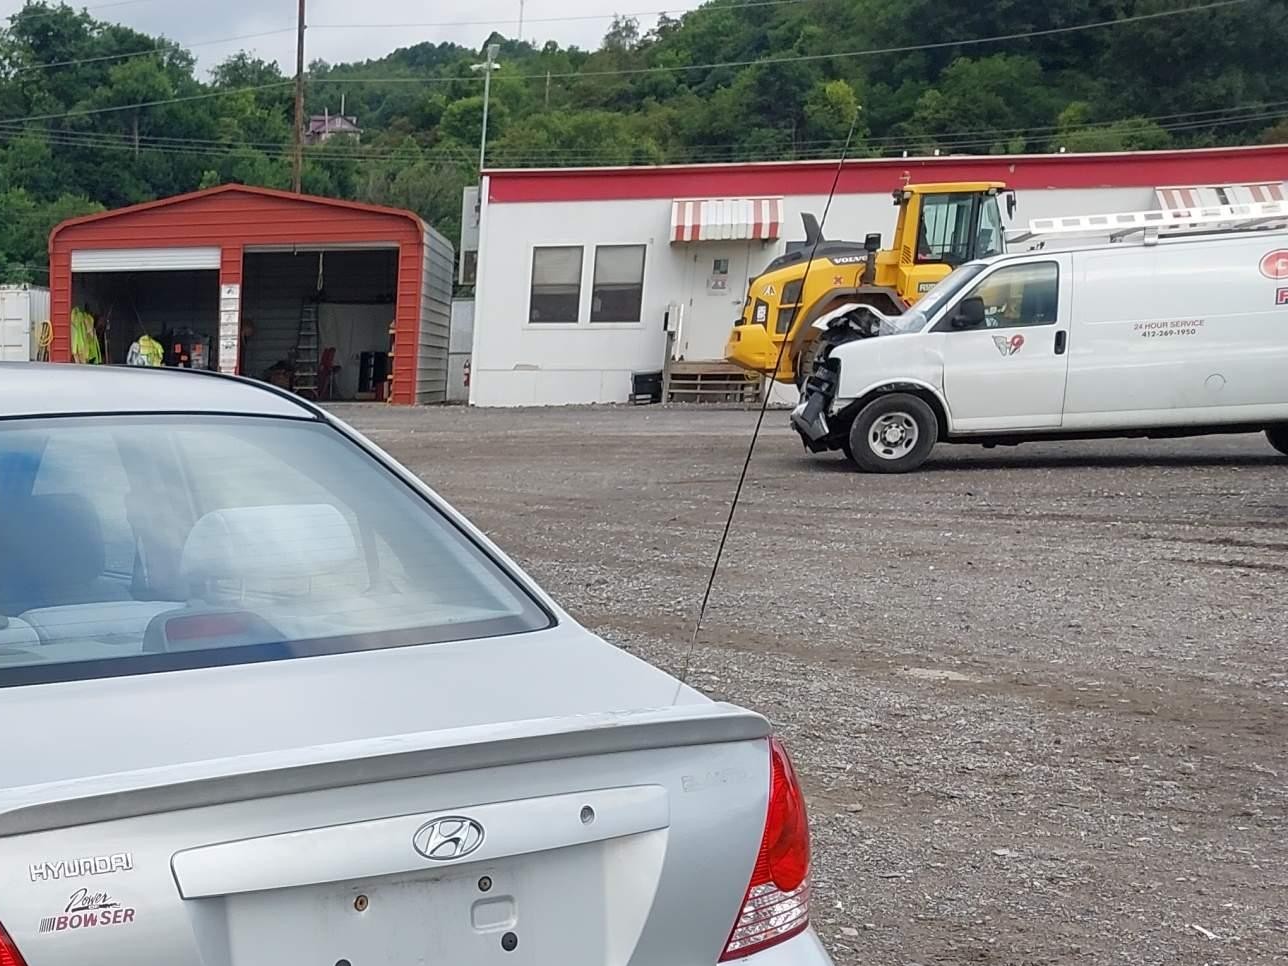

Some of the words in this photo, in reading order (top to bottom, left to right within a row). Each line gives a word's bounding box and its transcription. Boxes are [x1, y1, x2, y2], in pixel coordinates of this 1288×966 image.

[1144, 321, 1168, 329] HOUR
[1169, 319, 1205, 328] SERVICE
[29, 853, 134, 882] HYUNDAI
[65, 888, 111, 912] Power
[56, 908, 135, 931] BOWSER
